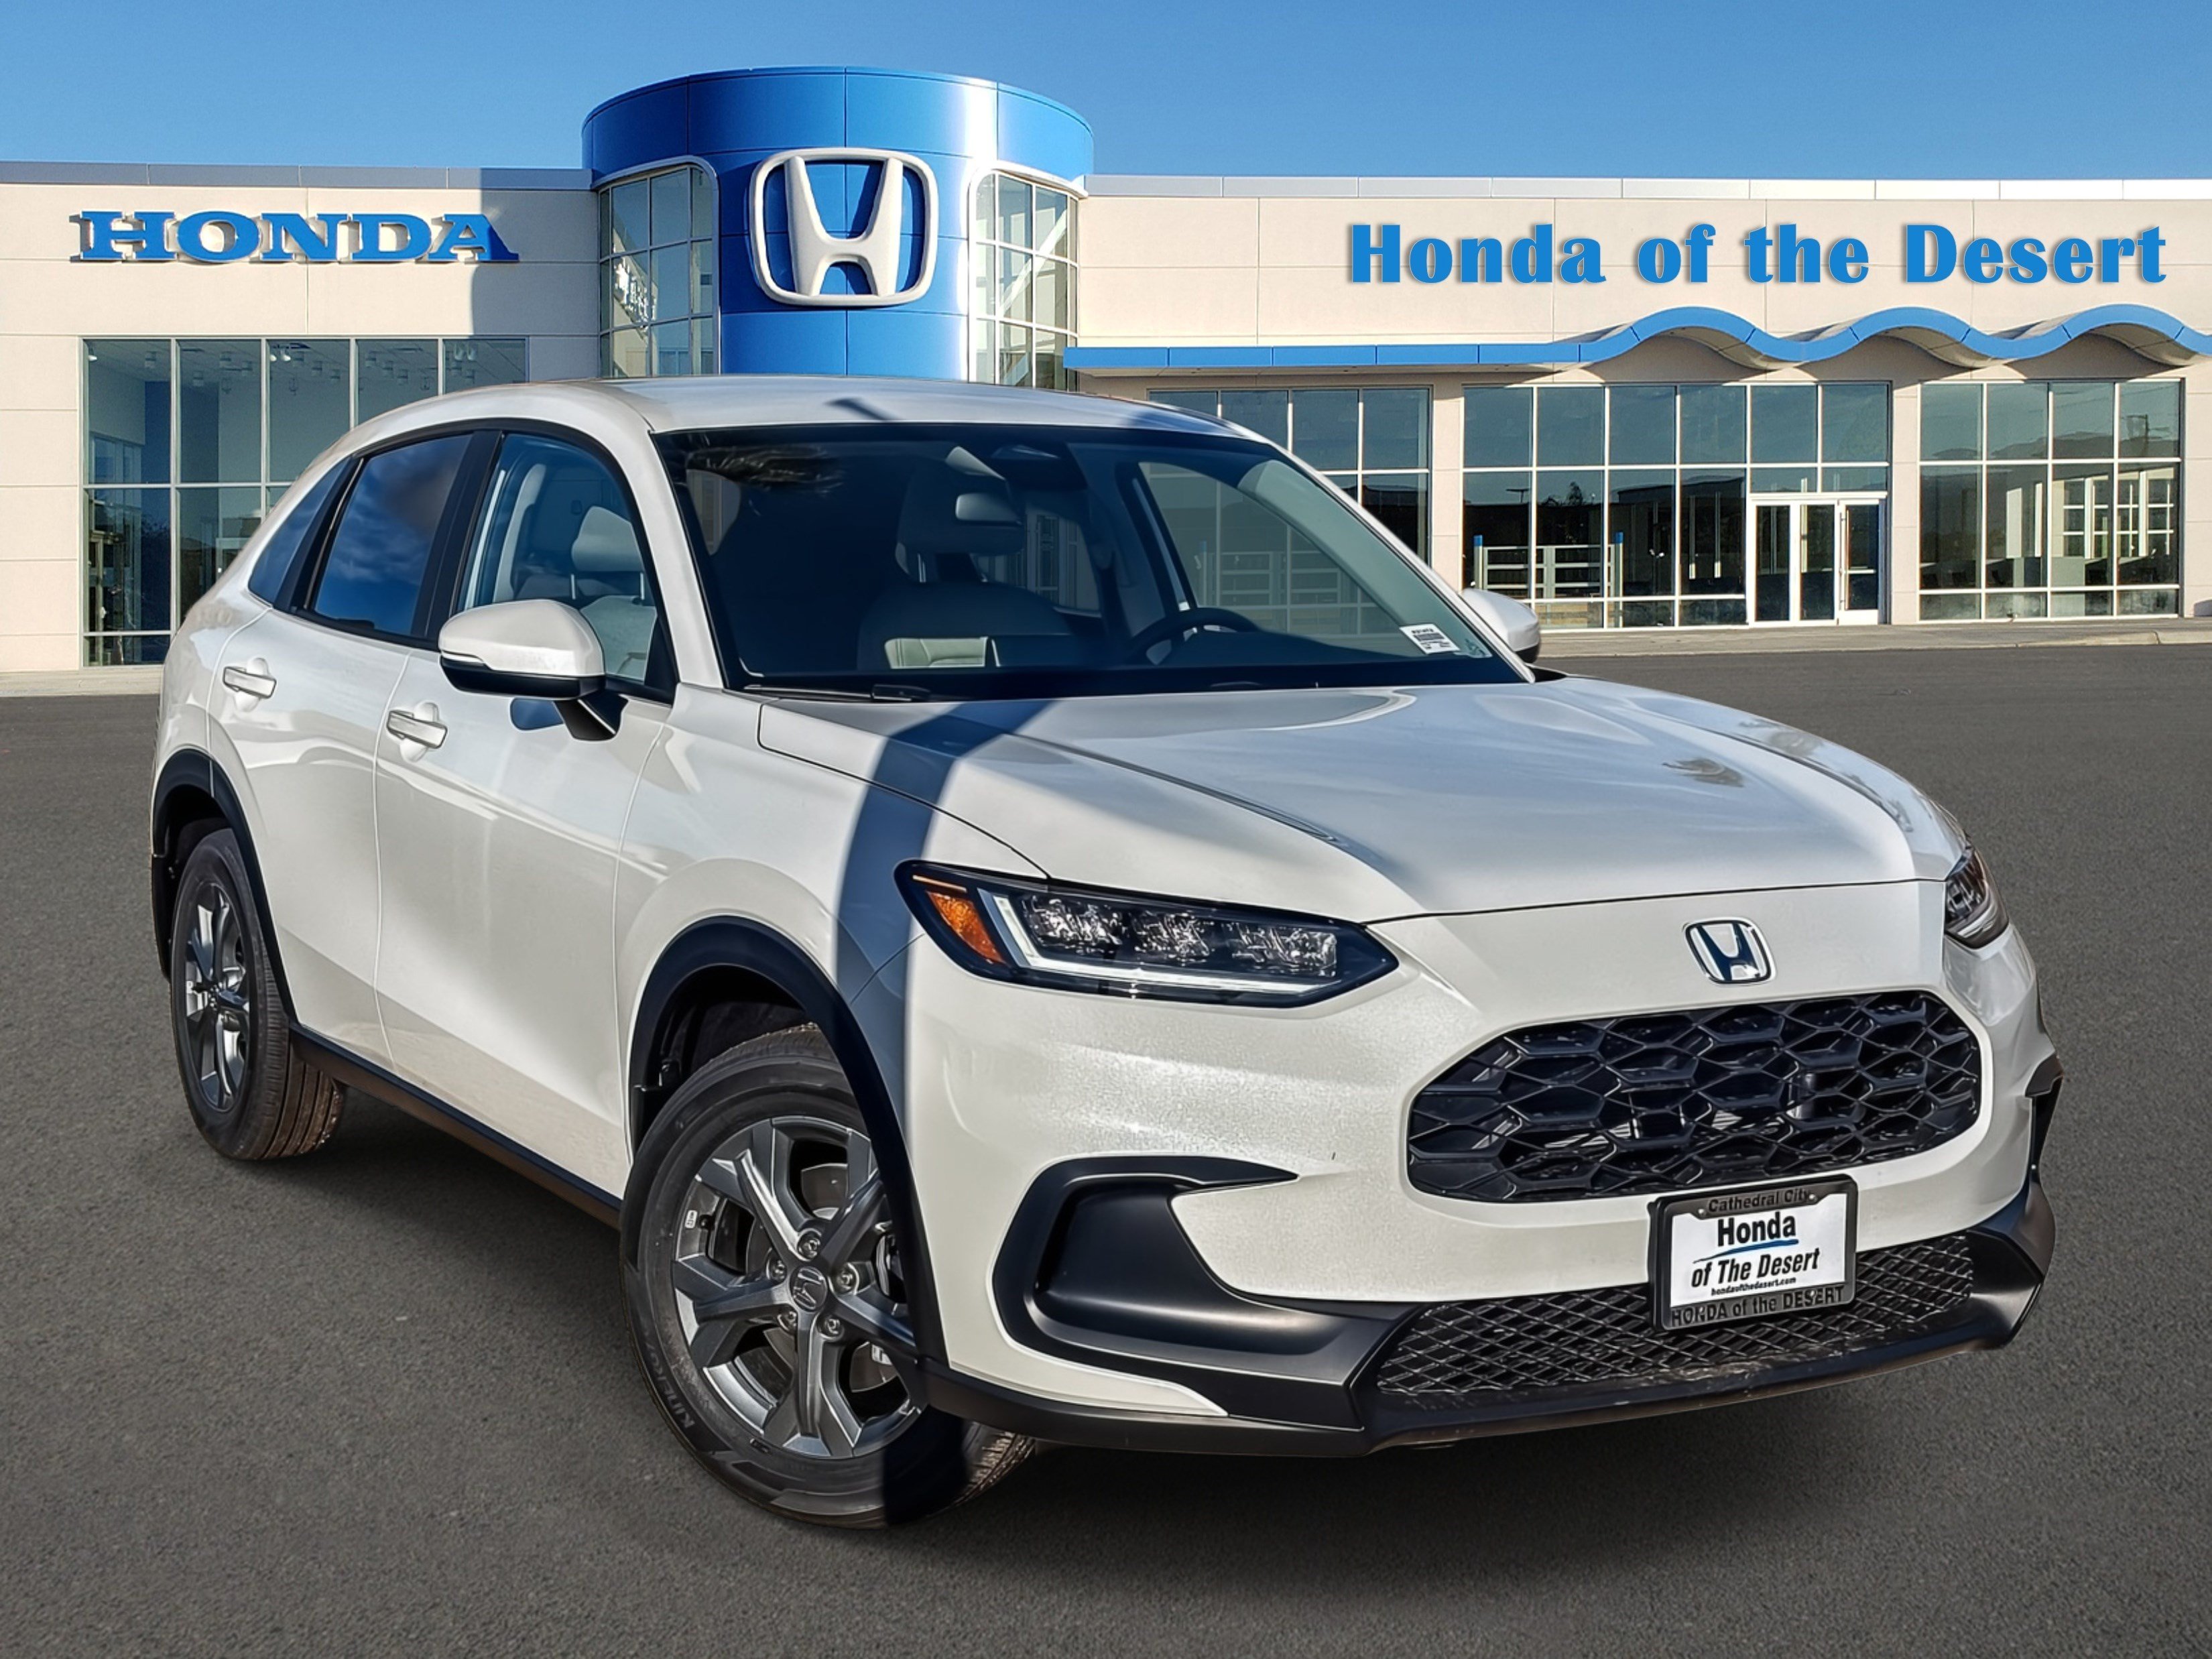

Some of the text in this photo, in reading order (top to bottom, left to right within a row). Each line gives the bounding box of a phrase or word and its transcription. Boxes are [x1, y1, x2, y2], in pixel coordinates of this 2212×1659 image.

[71, 210, 519, 262] HONDA
[1351, 223, 2167, 284] Honda of the Desert
[1709, 1188, 1810, 1212] Cathedral City
[1717, 1211, 1796, 1246] Honda
[1691, 1247, 1821, 1288] of The Desert
[1711, 1277, 1796, 1296] hondaofthedesert.com
[1671, 1285, 1844, 1327] HONDA of the DESERT
